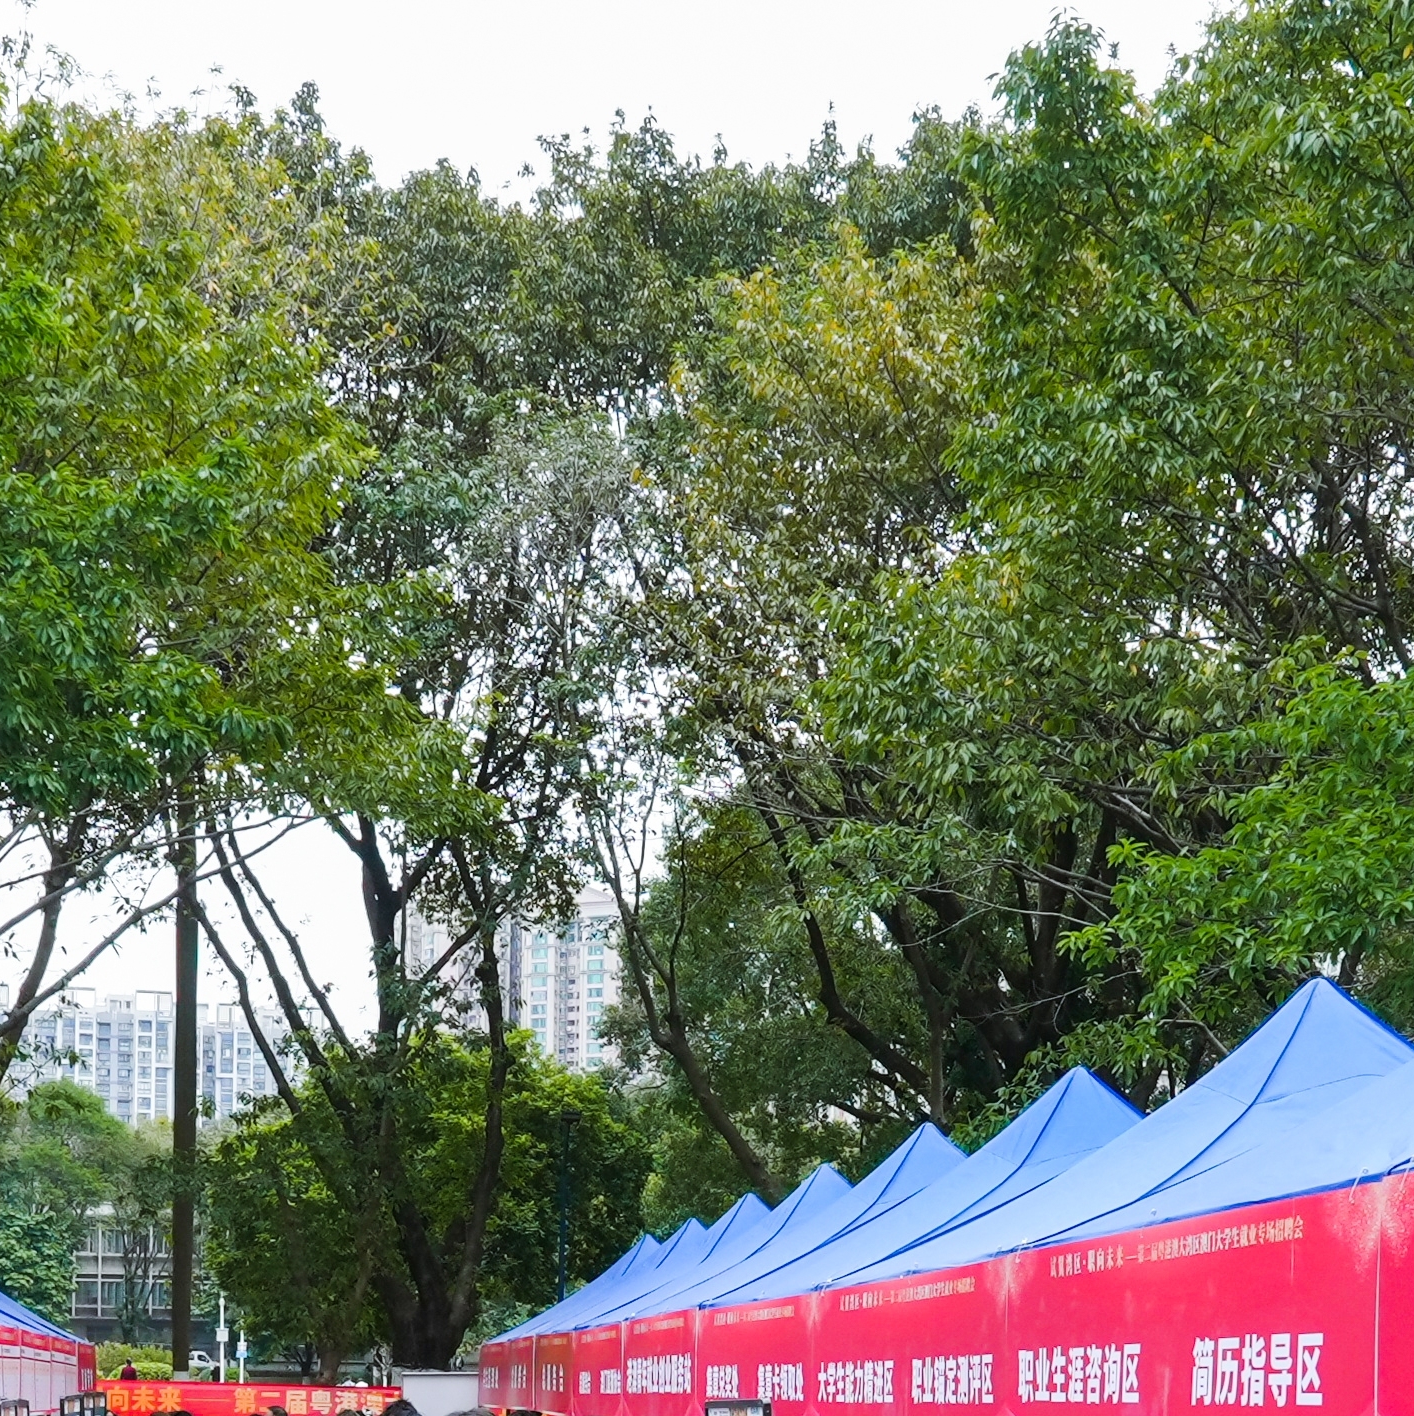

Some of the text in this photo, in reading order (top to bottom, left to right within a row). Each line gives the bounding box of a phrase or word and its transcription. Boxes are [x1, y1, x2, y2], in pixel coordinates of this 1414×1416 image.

[817, 1359, 894, 1404] 大学生能力精进区
[911, 1354, 994, 1405] 职业锚定测评区
[1017, 1343, 1142, 1405] 职业生涯咨询区
[1190, 1332, 1324, 1408] 简历指导区
